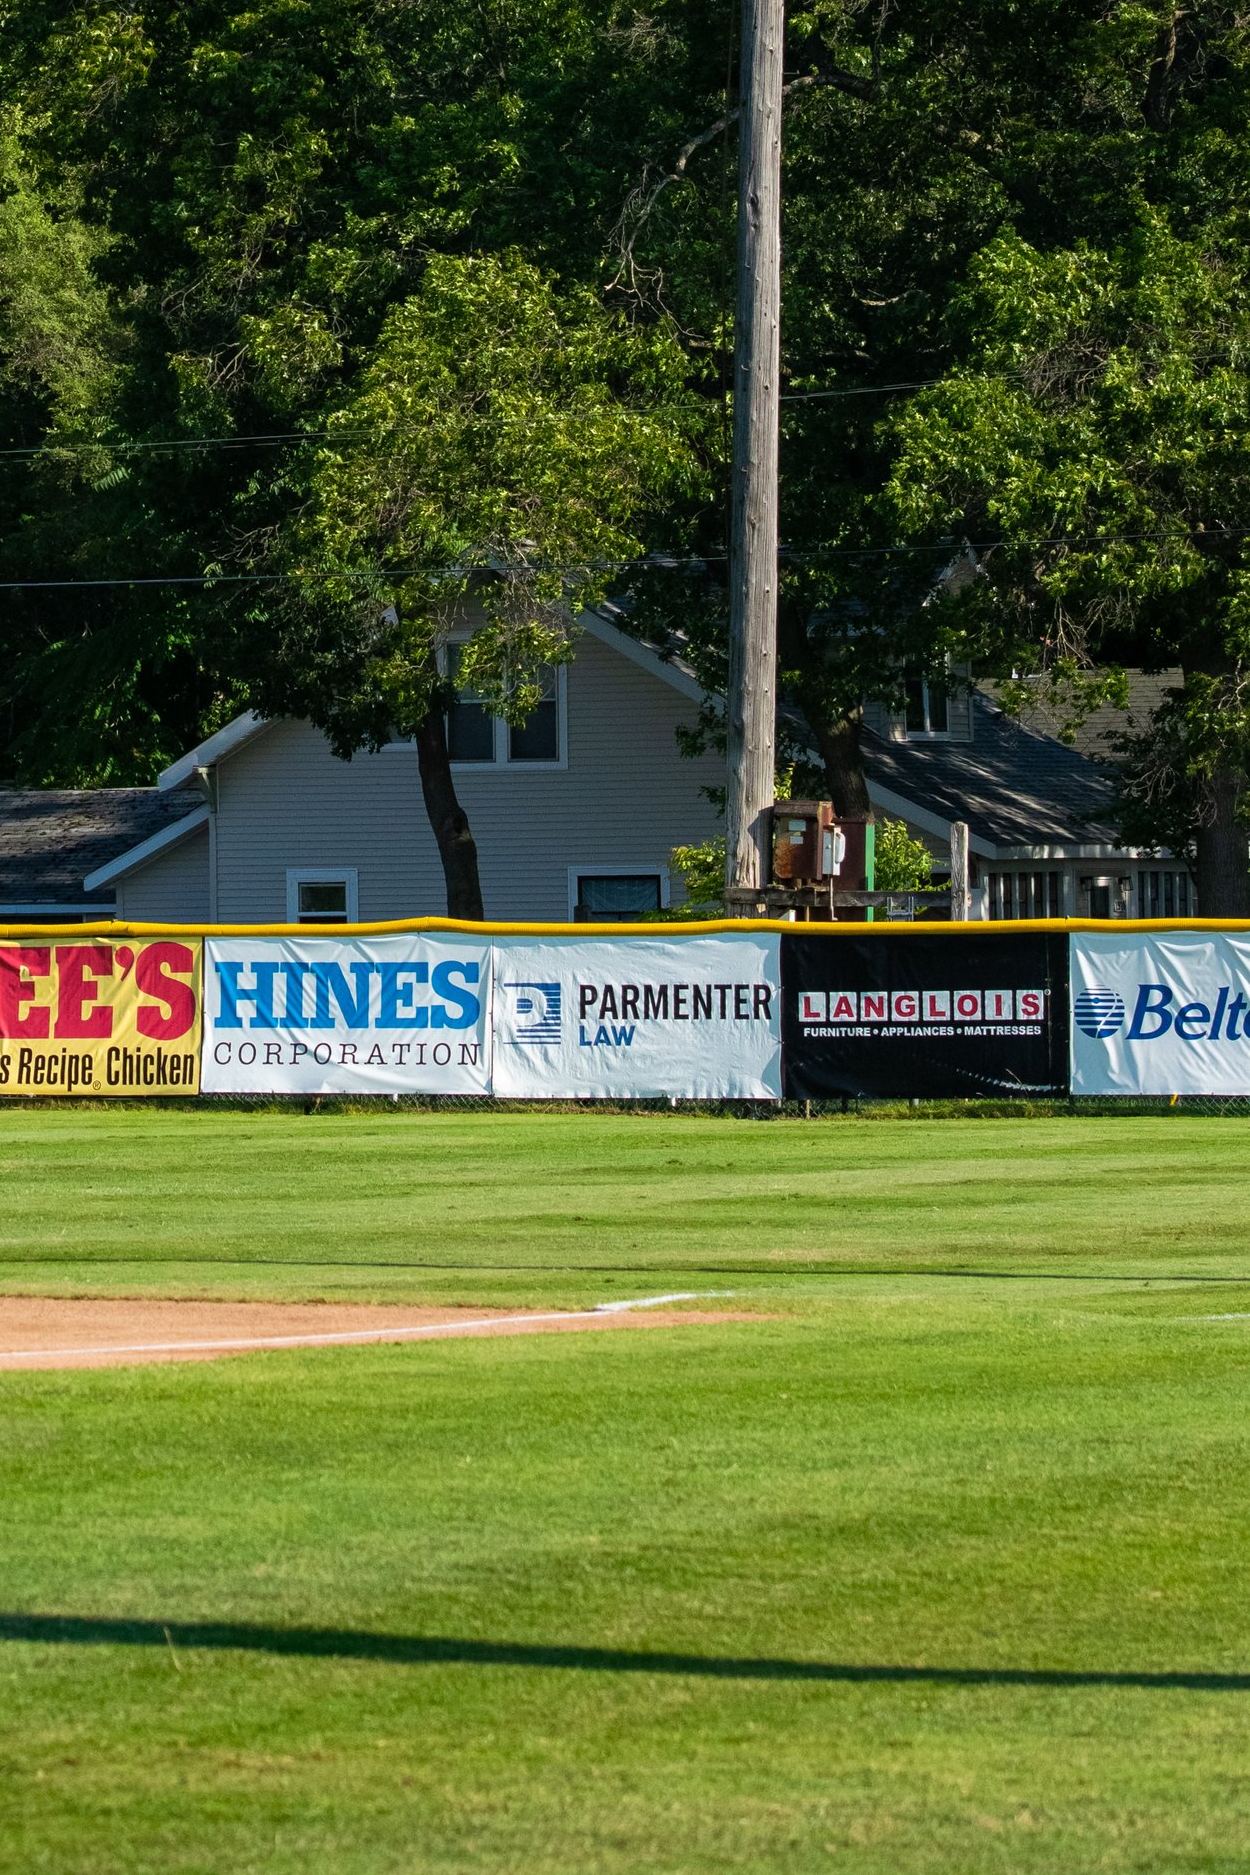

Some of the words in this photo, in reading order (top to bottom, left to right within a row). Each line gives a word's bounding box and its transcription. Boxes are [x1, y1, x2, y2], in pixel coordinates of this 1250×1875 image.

[214, 959, 481, 1030] HINES
[579, 983, 773, 1021] PARMENTER
[802, 993, 1042, 1019] LANGLOIS
[1125, 983, 1250, 1042] Belt
[579, 1025, 636, 1047] LAW
[803, 1027, 872, 1037] FURNITURE
[881, 1026, 955, 1037] APPLIANCES
[964, 1025, 1042, 1036] MATTRESSES
[17, 1047, 93, 1092] Recipe
[107, 1046, 195, 1086] Chicken
[214, 1042, 480, 1067] CORPORATION
